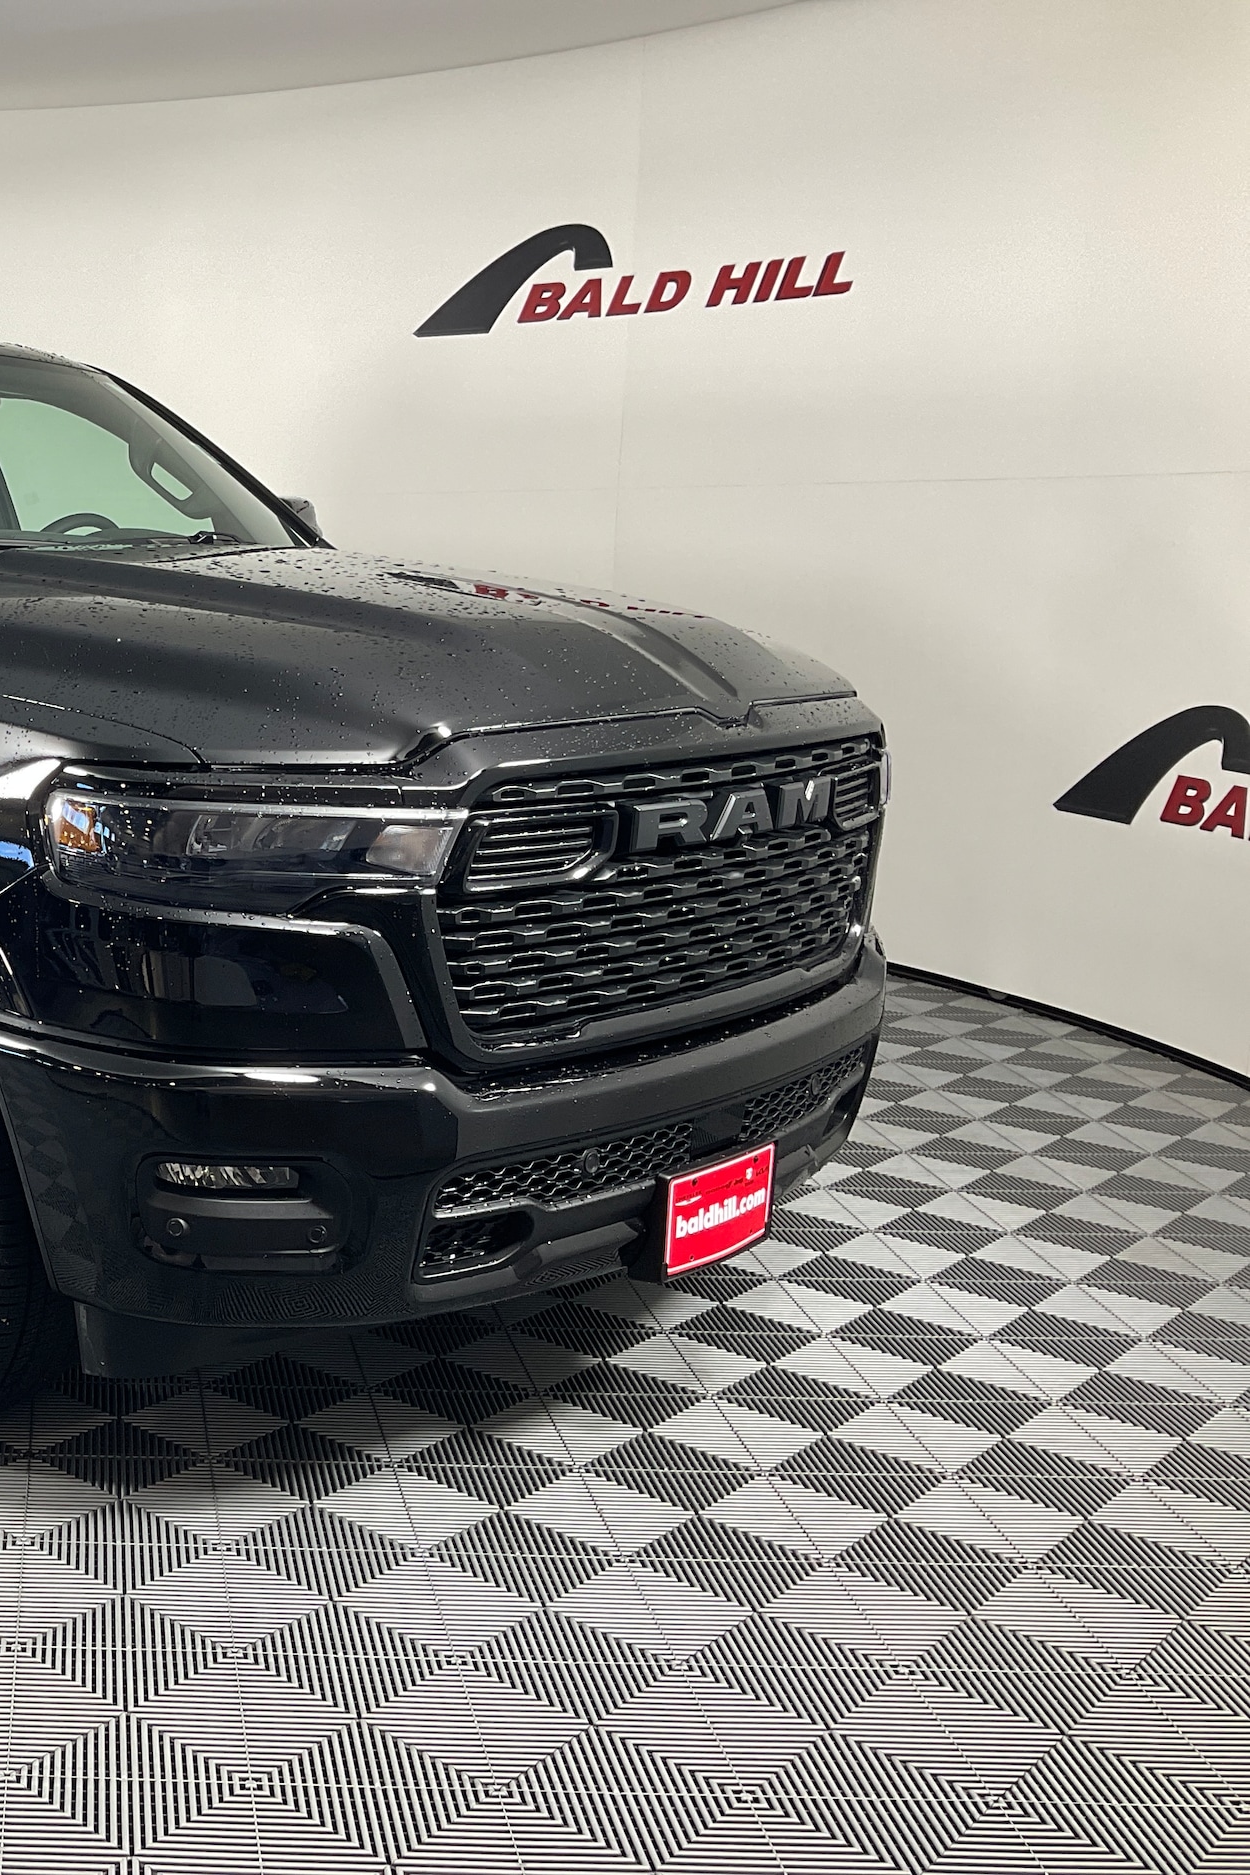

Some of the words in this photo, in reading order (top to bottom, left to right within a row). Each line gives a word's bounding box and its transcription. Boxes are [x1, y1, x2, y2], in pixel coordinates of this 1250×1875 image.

[517, 270, 692, 324] BALD
[705, 251, 853, 308] HILL
[630, 776, 832, 851] RAM
[1160, 775, 1250, 841] BA
[675, 1187, 766, 1239] baldhill.com
